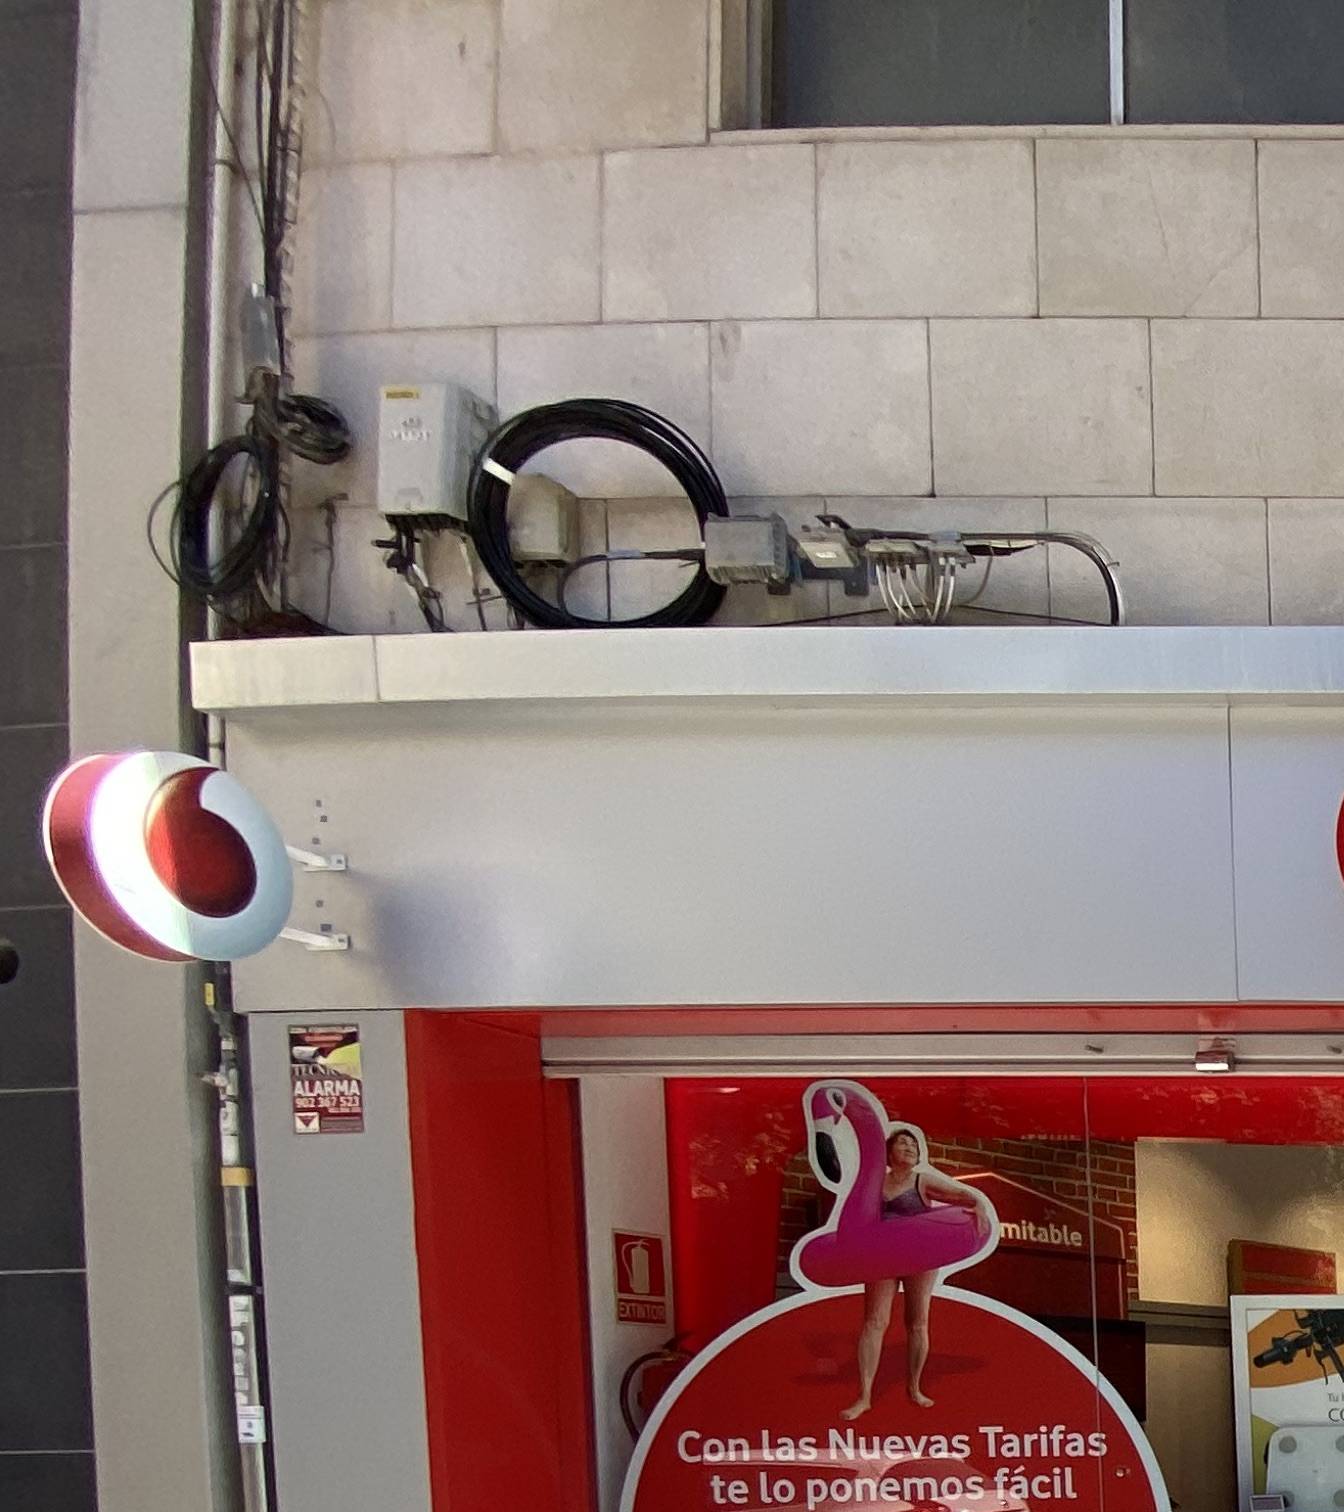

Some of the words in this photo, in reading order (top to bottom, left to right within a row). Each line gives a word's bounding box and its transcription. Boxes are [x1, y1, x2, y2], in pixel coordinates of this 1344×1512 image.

[294, 1080, 361, 1096] ALARMA
[619, 1301, 665, 1321] EXTINTOR
[1327, 1393, 1339, 1402] Tu
[677, 1429, 750, 1464] Con
[760, 1429, 817, 1463] las
[828, 1428, 970, 1462] Nuevas
[979, 1425, 1108, 1458] Tarifas
[710, 1474, 749, 1504] te
[759, 1471, 796, 1504] lo
[807, 1475, 984, 1510] ponemos
[994, 1467, 1077, 1500] fácil
